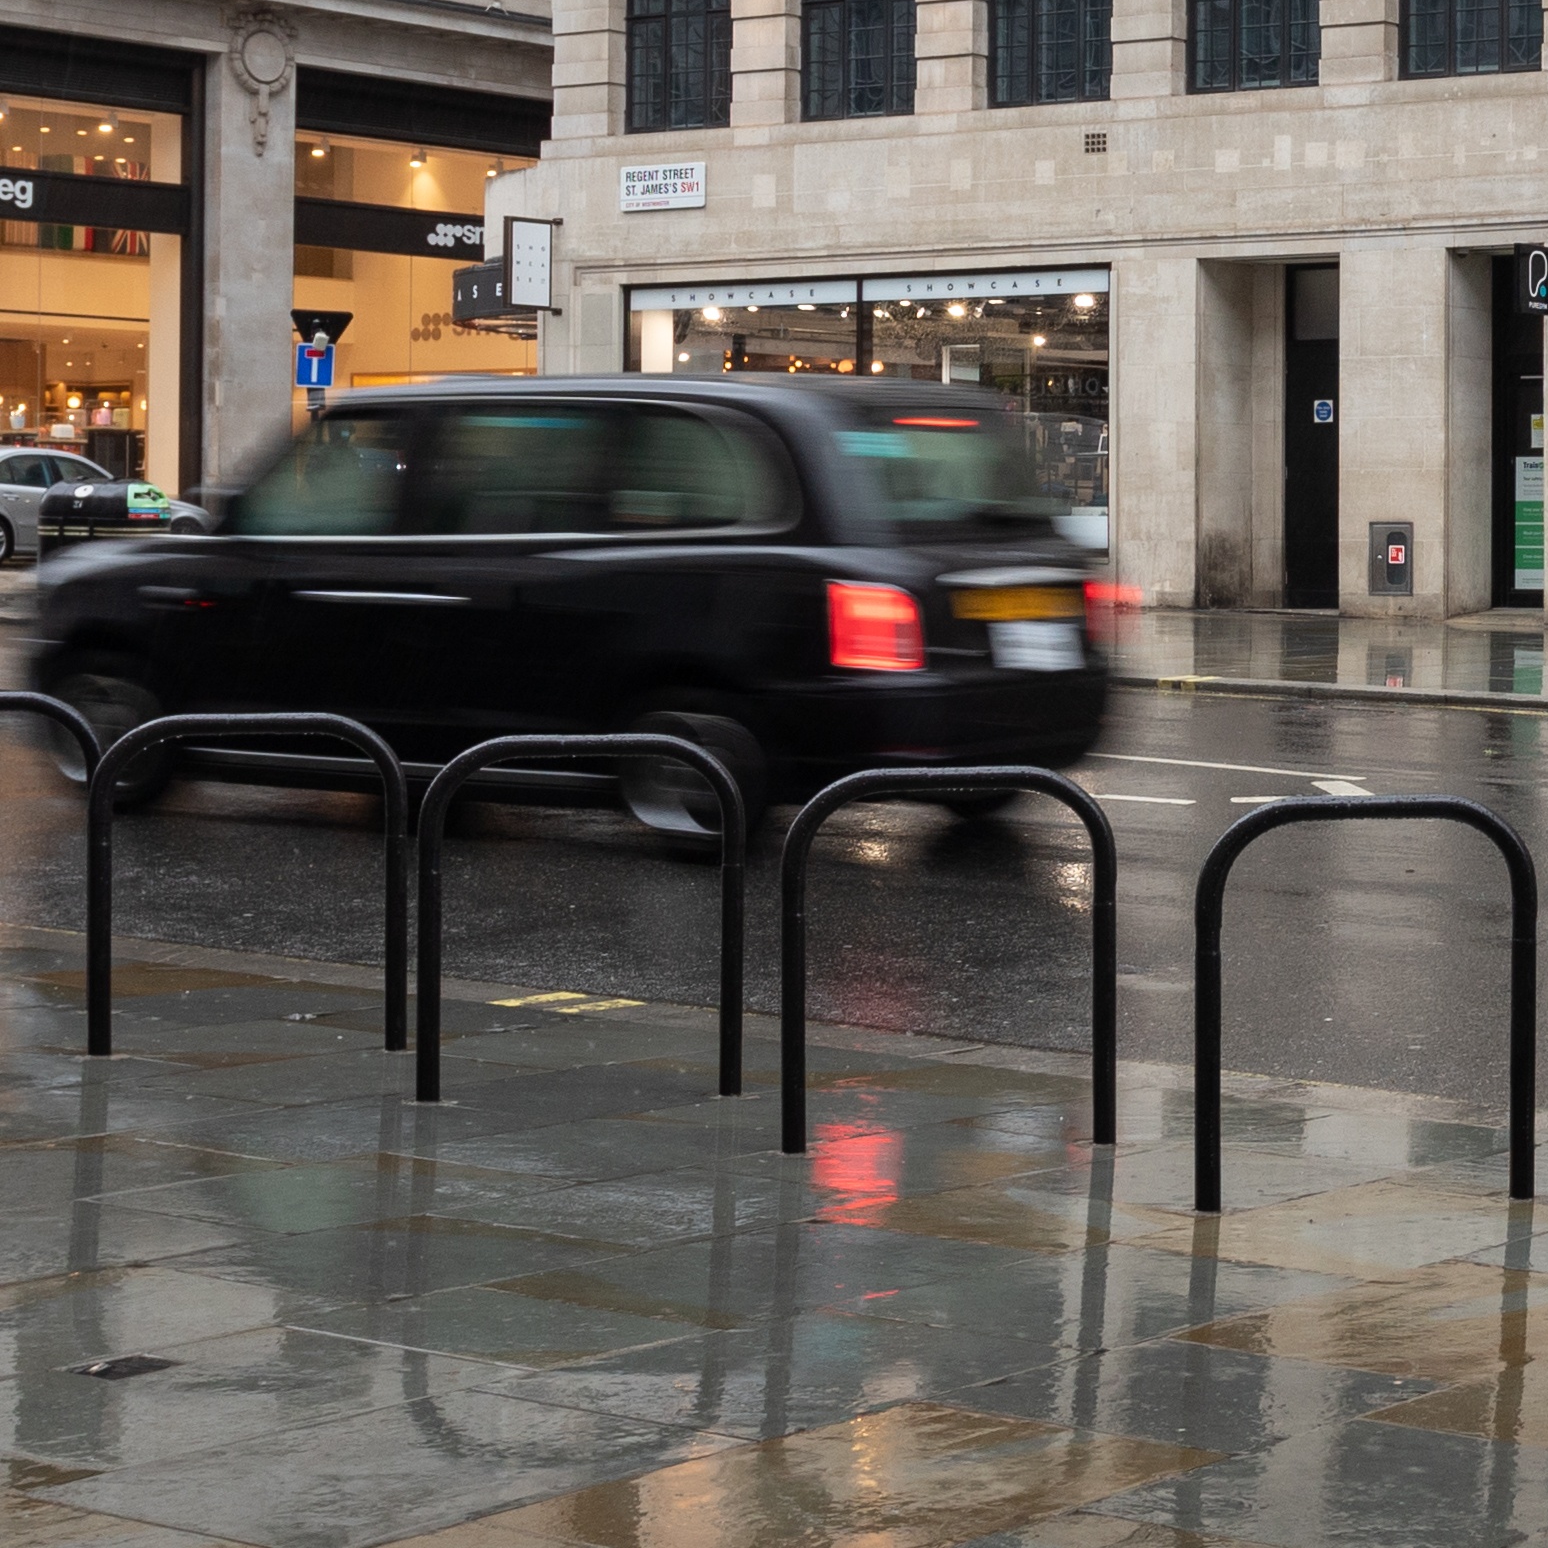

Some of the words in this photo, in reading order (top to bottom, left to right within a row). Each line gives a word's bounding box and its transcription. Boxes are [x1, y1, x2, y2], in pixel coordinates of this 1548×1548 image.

[625, 170, 659, 183] REGENT
[662, 167, 695, 181] STREET
[640, 182, 678, 196] JAMES'S
[680, 181, 700, 193] SW1
[906, 278, 1063, 293] SHOWCASE
[670, 288, 816, 303] SHOWCASE
